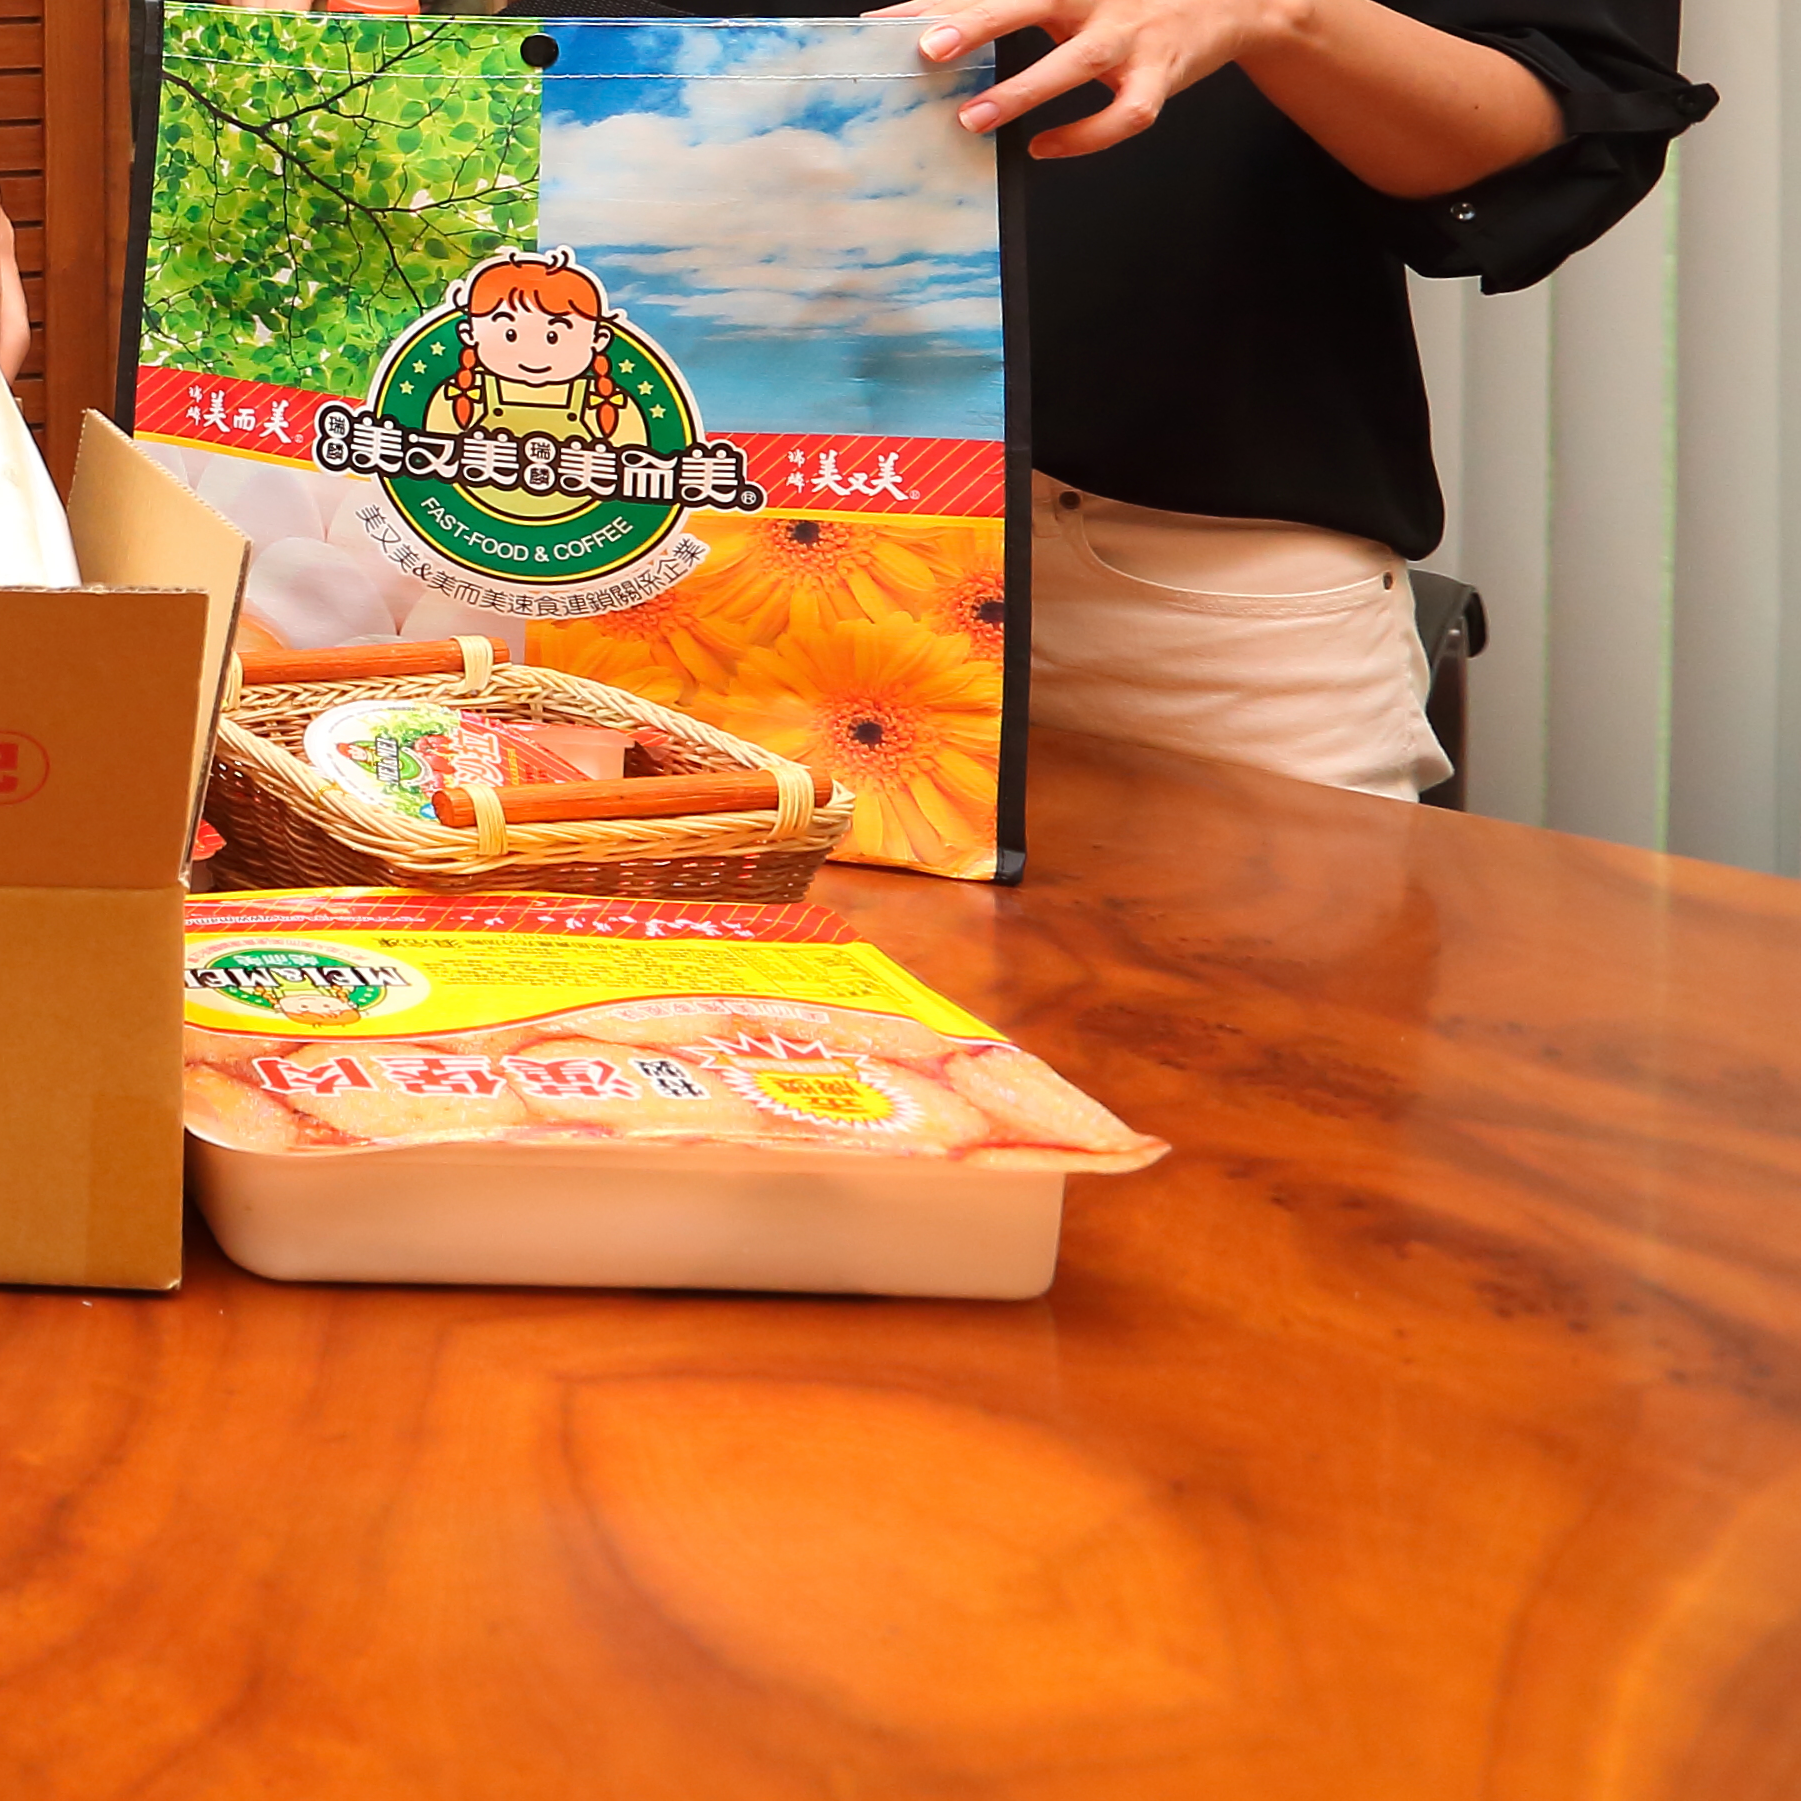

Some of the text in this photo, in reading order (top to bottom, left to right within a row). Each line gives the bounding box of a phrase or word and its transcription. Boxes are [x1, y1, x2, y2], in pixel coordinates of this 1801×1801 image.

[202, 387, 292, 444] 美而美
[350, 416, 519, 485] 美又美
[558, 443, 738, 504] 美而美
[809, 451, 908, 502] 美又美
[419, 496, 634, 563] FAST-FOOD & COFFEE
[184, 965, 409, 991] MEI&MEI
[256, 1053, 639, 1103] 漢堡肉
